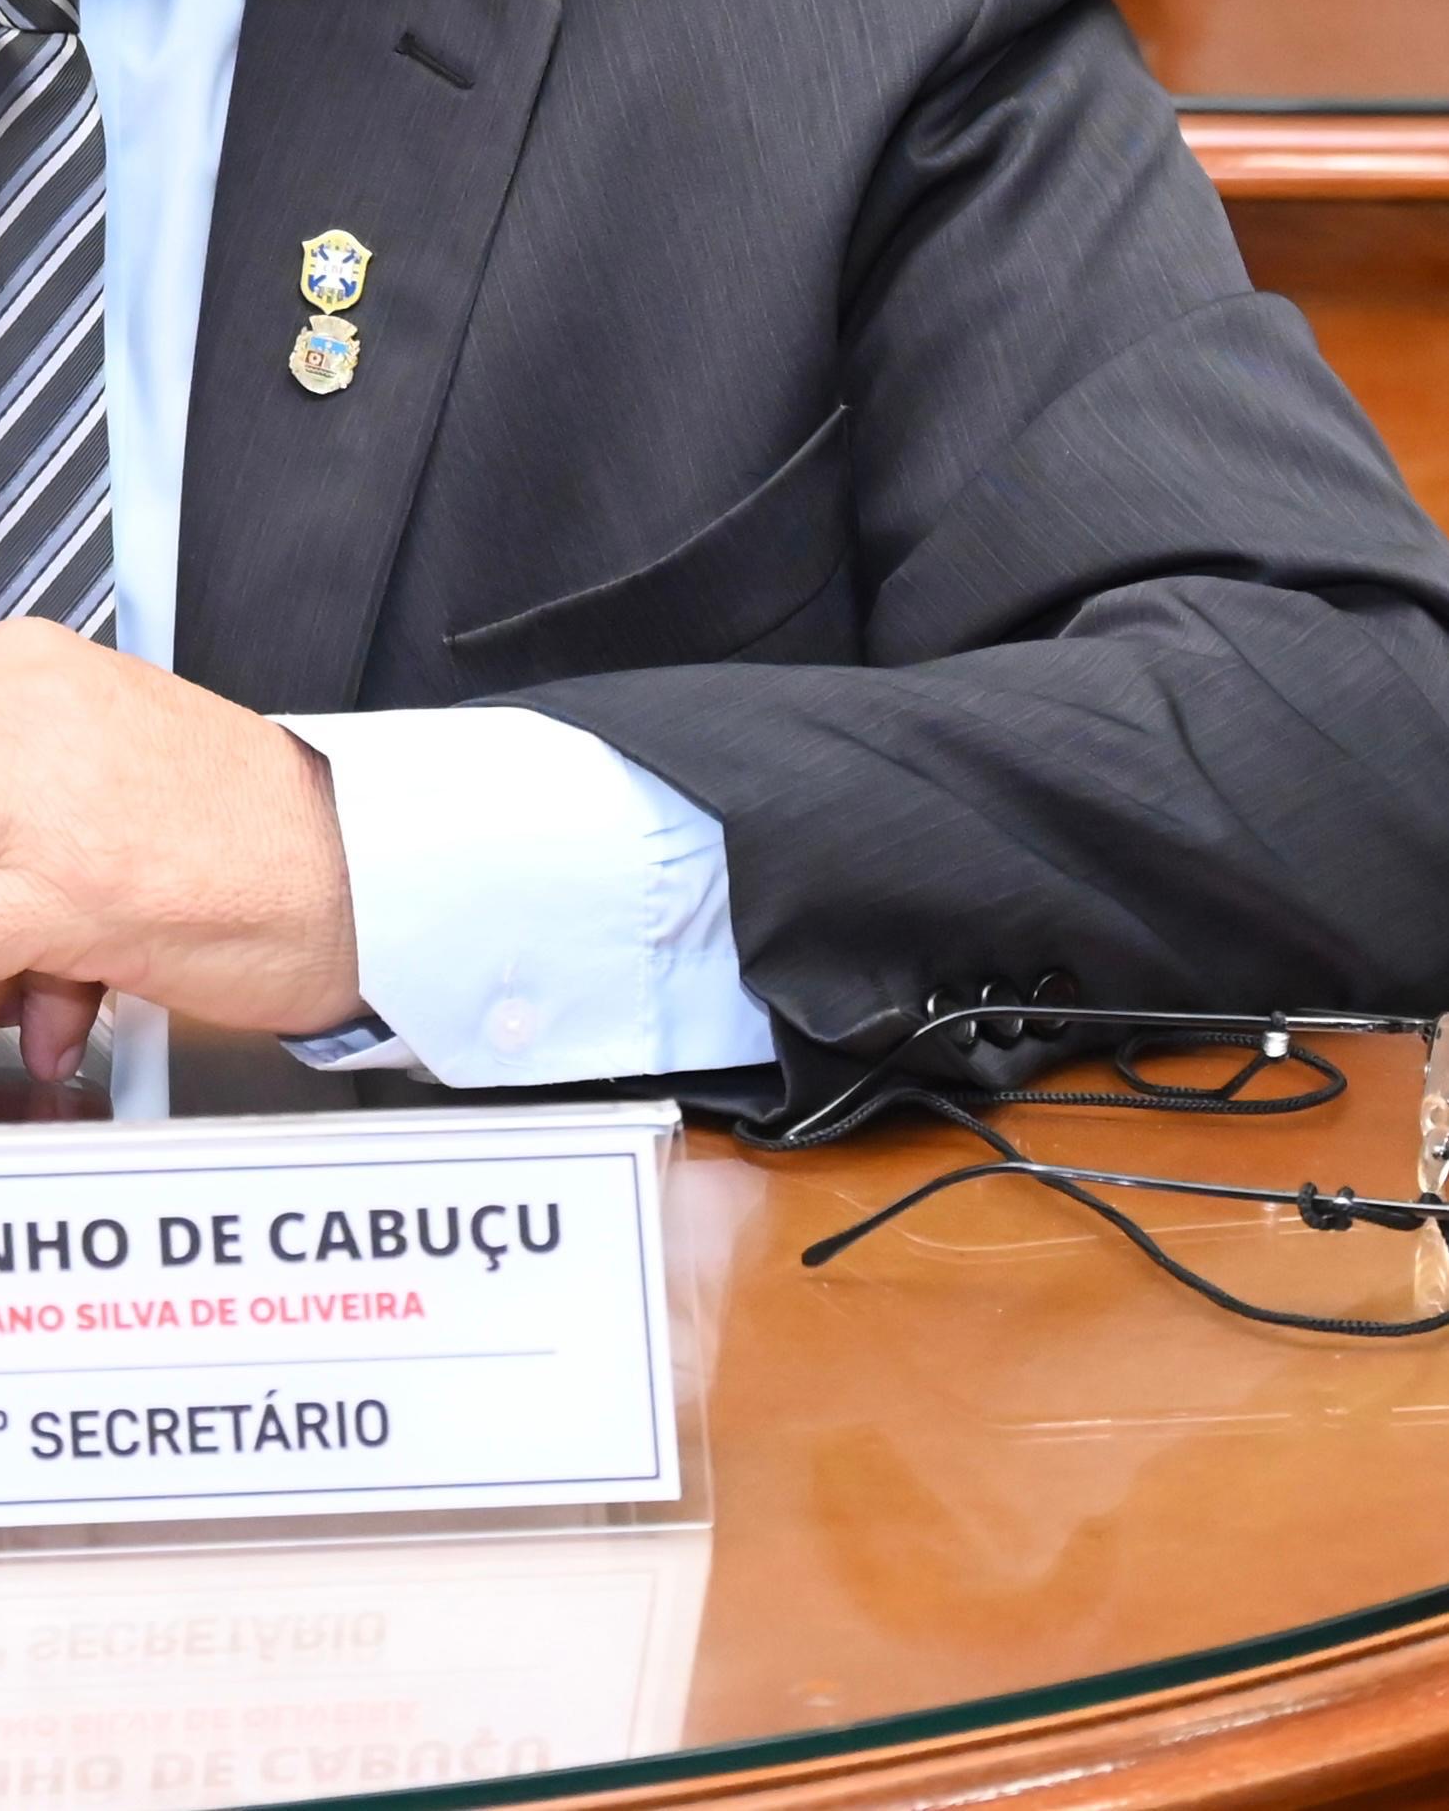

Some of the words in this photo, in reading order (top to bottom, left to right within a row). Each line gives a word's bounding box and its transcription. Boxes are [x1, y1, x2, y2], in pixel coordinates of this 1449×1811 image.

[157, 1213, 243, 1268] DE
[268, 1202, 561, 1273] CABUÇU
[76, 1300, 180, 1331] SILVA
[190, 1298, 237, 1327] DE
[249, 1291, 424, 1325] OLIVEIRA
[29, 1389, 390, 1461] SECRETÁRIO
